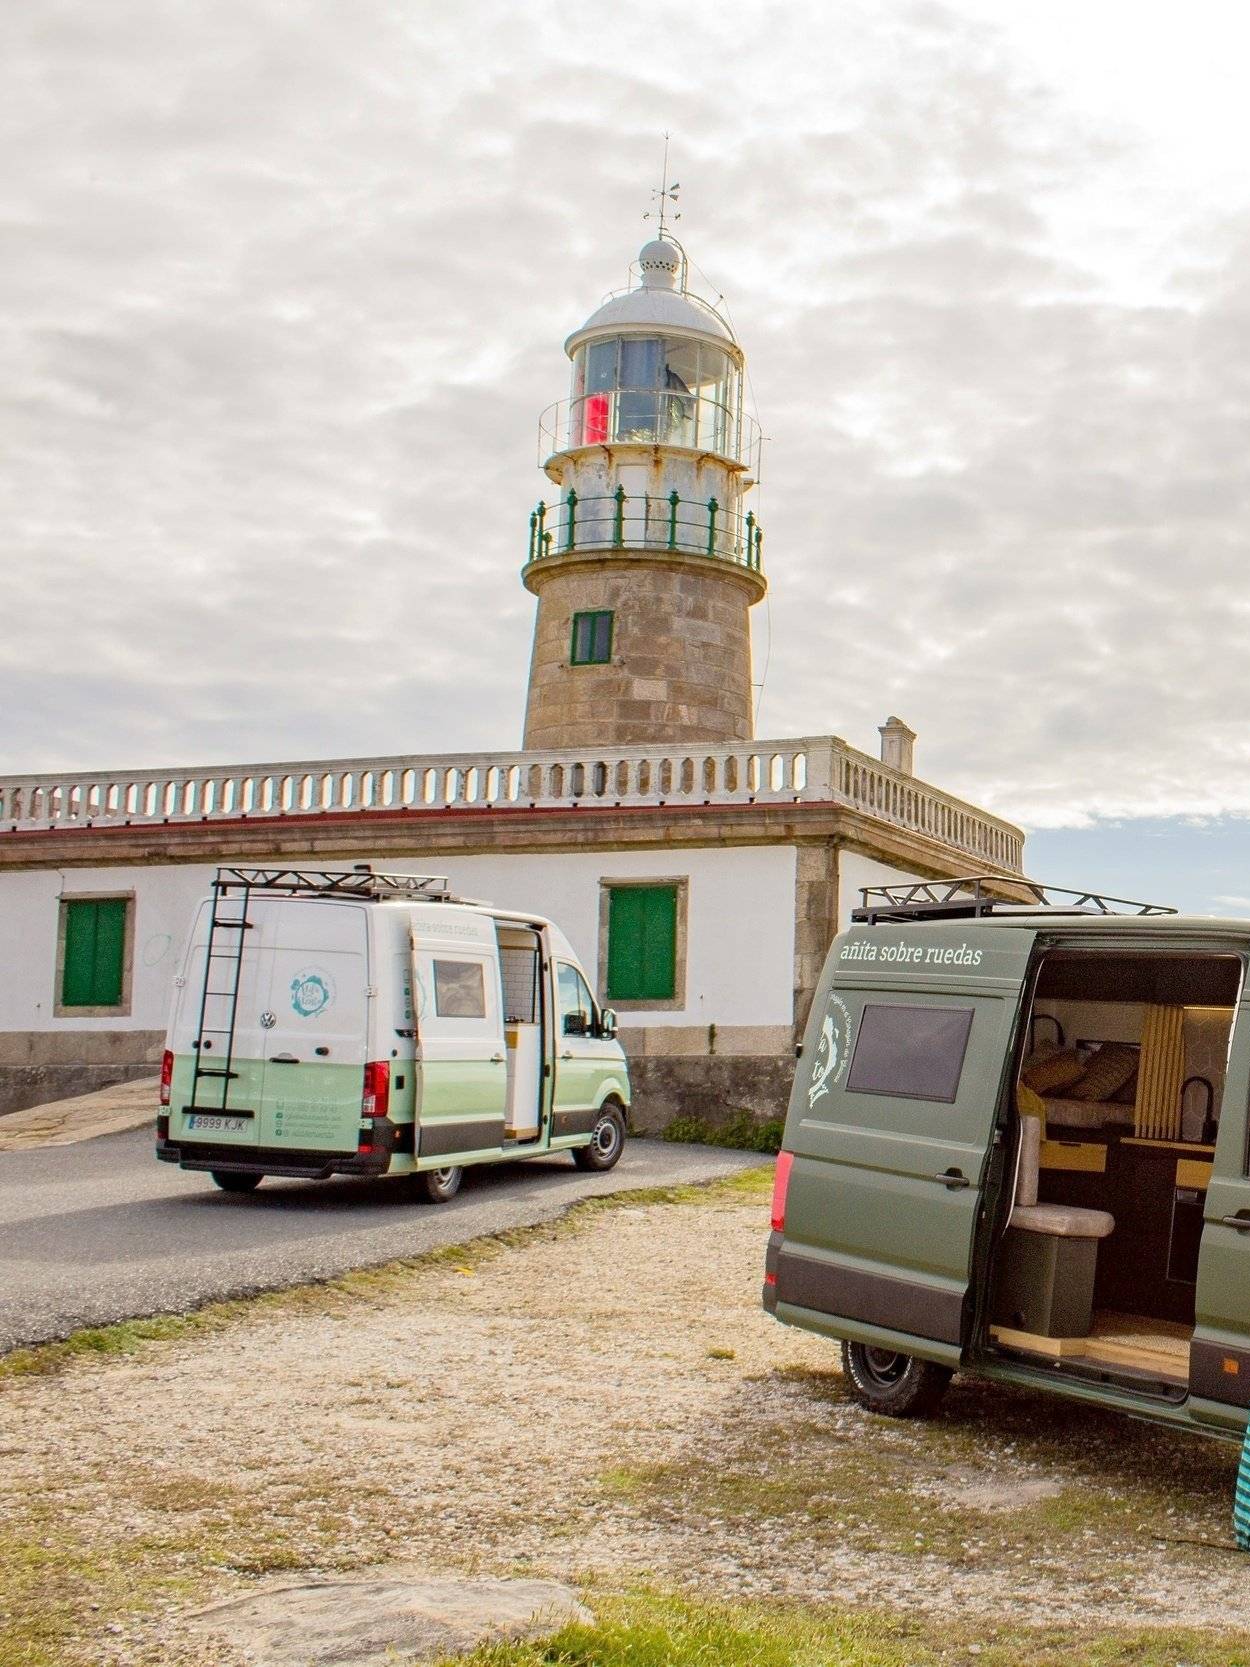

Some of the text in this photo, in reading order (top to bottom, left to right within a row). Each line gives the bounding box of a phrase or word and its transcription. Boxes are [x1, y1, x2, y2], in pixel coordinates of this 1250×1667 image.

[840, 940, 983, 965] añita sobre ruedas
[224, 1118, 246, 1131] KJK
